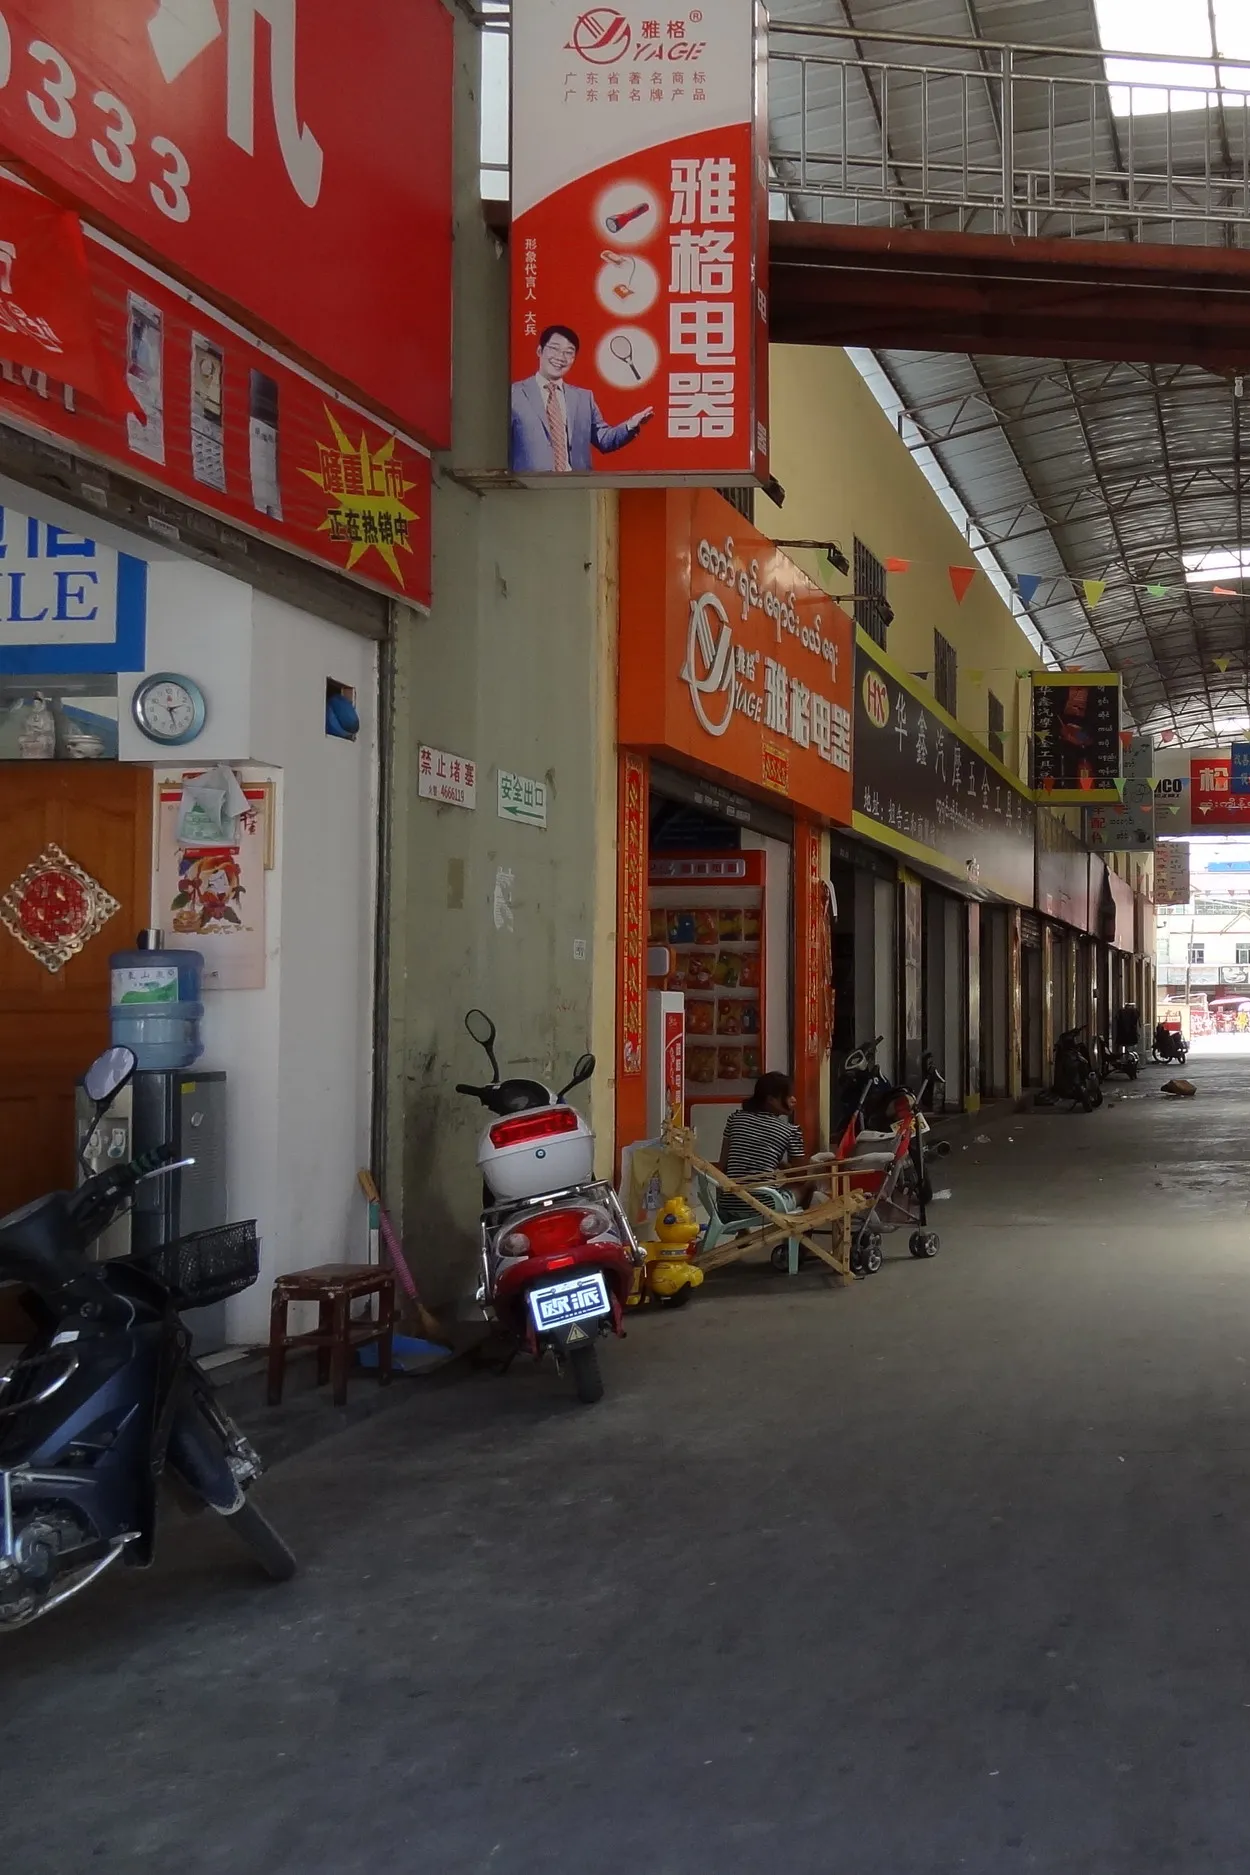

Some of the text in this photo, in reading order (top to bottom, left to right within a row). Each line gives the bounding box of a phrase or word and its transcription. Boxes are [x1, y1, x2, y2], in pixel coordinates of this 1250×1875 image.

[641, 19, 686, 39] 雅格
[632, 41, 707, 62] YAGE
[564, 70, 706, 86] 广东省著名商标
[564, 88, 706, 103] 广东省名牌产品
[0, 10, 191, 223] 333
[668, 156, 736, 439] 雅格电器
[319, 449, 405, 500] 隆重上市
[327, 508, 409, 546] 正在热销中
[0, 571, 99, 622] LE
[763, 656, 850, 773] 雅格电器
[420, 748, 474, 788] 禁止堵塞
[501, 775, 544, 808] 安全出口
[540, 1287, 600, 1319] 欧派
